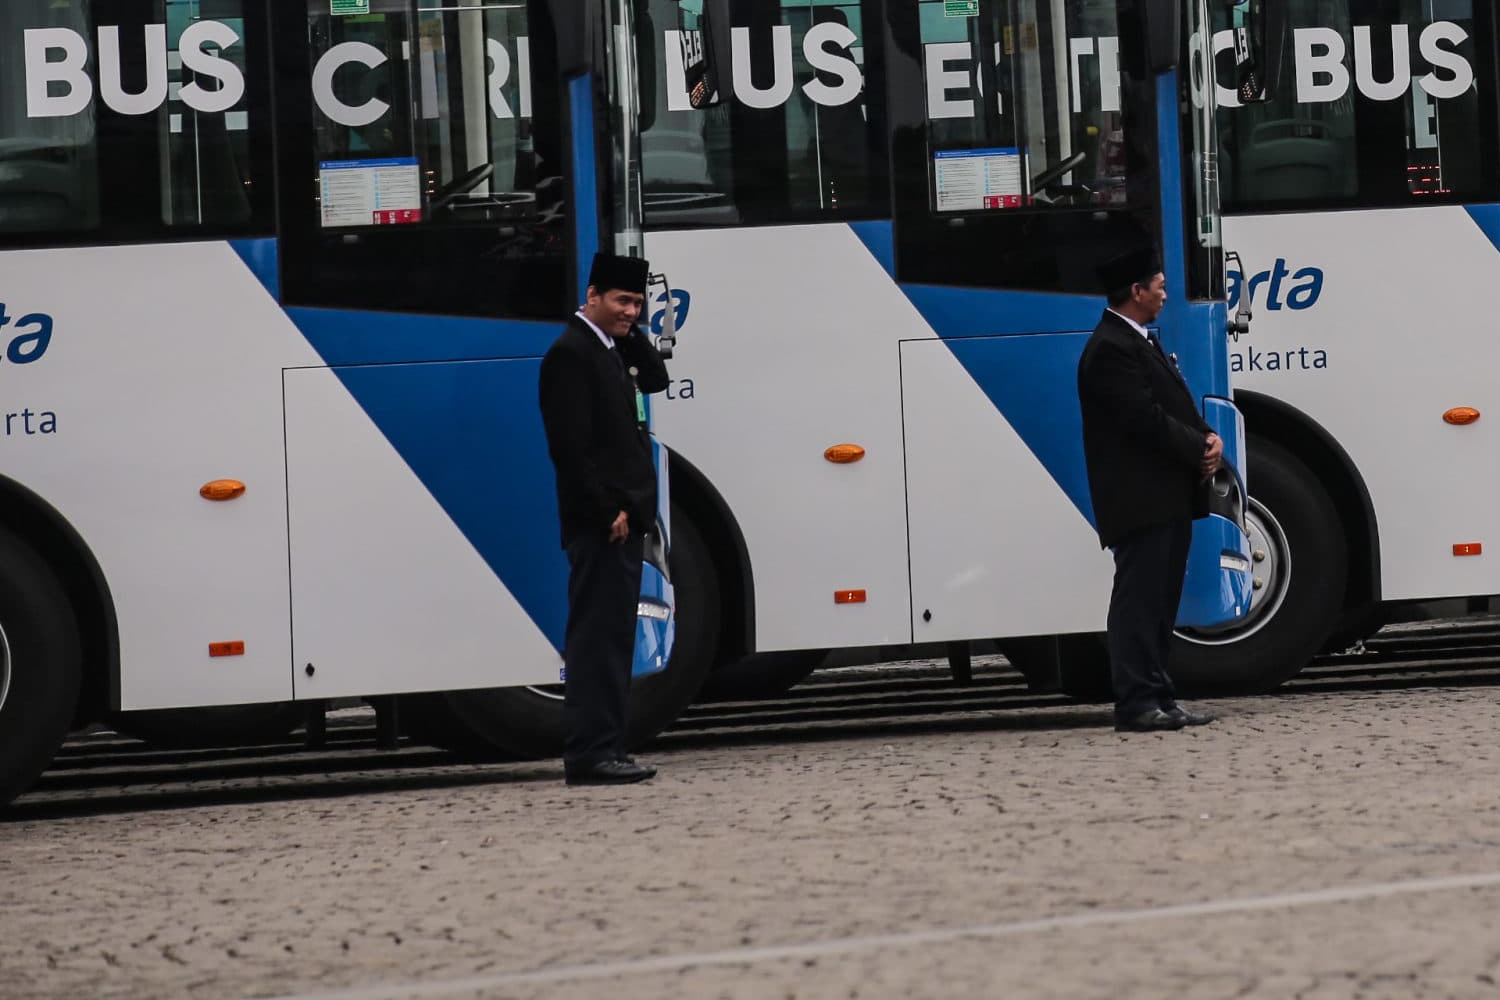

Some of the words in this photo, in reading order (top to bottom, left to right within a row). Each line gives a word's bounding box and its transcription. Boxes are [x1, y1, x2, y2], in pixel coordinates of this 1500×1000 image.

[24, 20, 246, 118] BUS
[1294, 21, 1474, 104] BUS
[1230, 346, 1328, 373] akarta
[5, 408, 57, 436] rta
